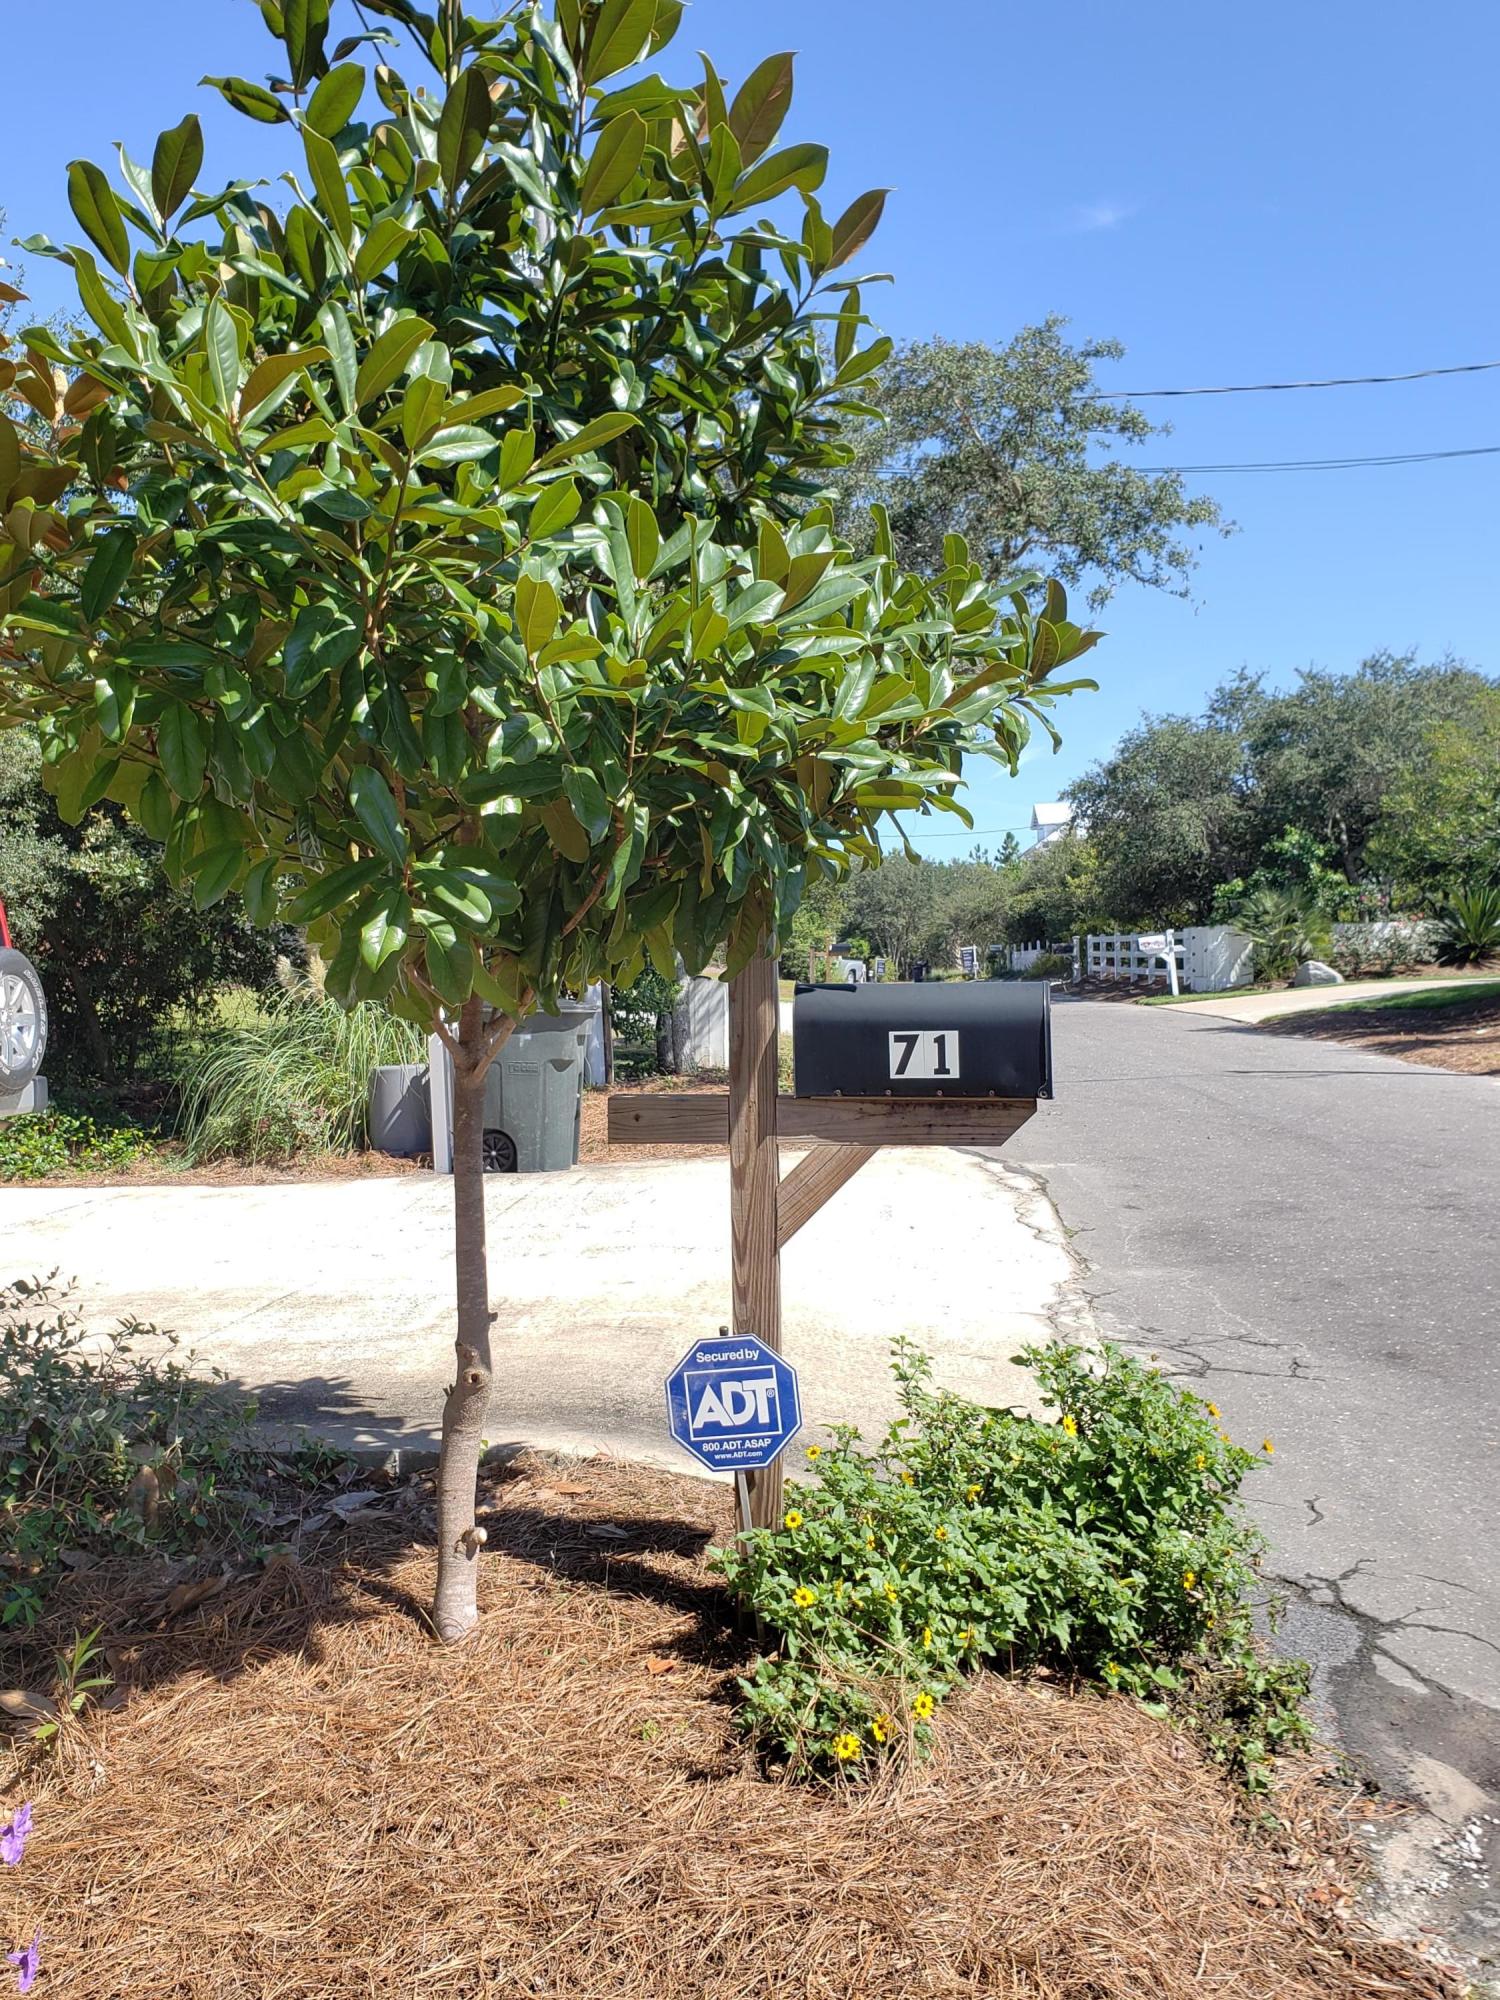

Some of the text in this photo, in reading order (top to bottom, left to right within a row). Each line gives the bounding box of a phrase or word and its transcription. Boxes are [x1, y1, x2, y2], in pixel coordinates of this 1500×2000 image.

[893, 1033, 951, 1075] 71
[696, 1349, 760, 1363] Secured by
[692, 1378, 776, 1429] ADT
[714, 1451, 763, 1460] www.ADT.com
